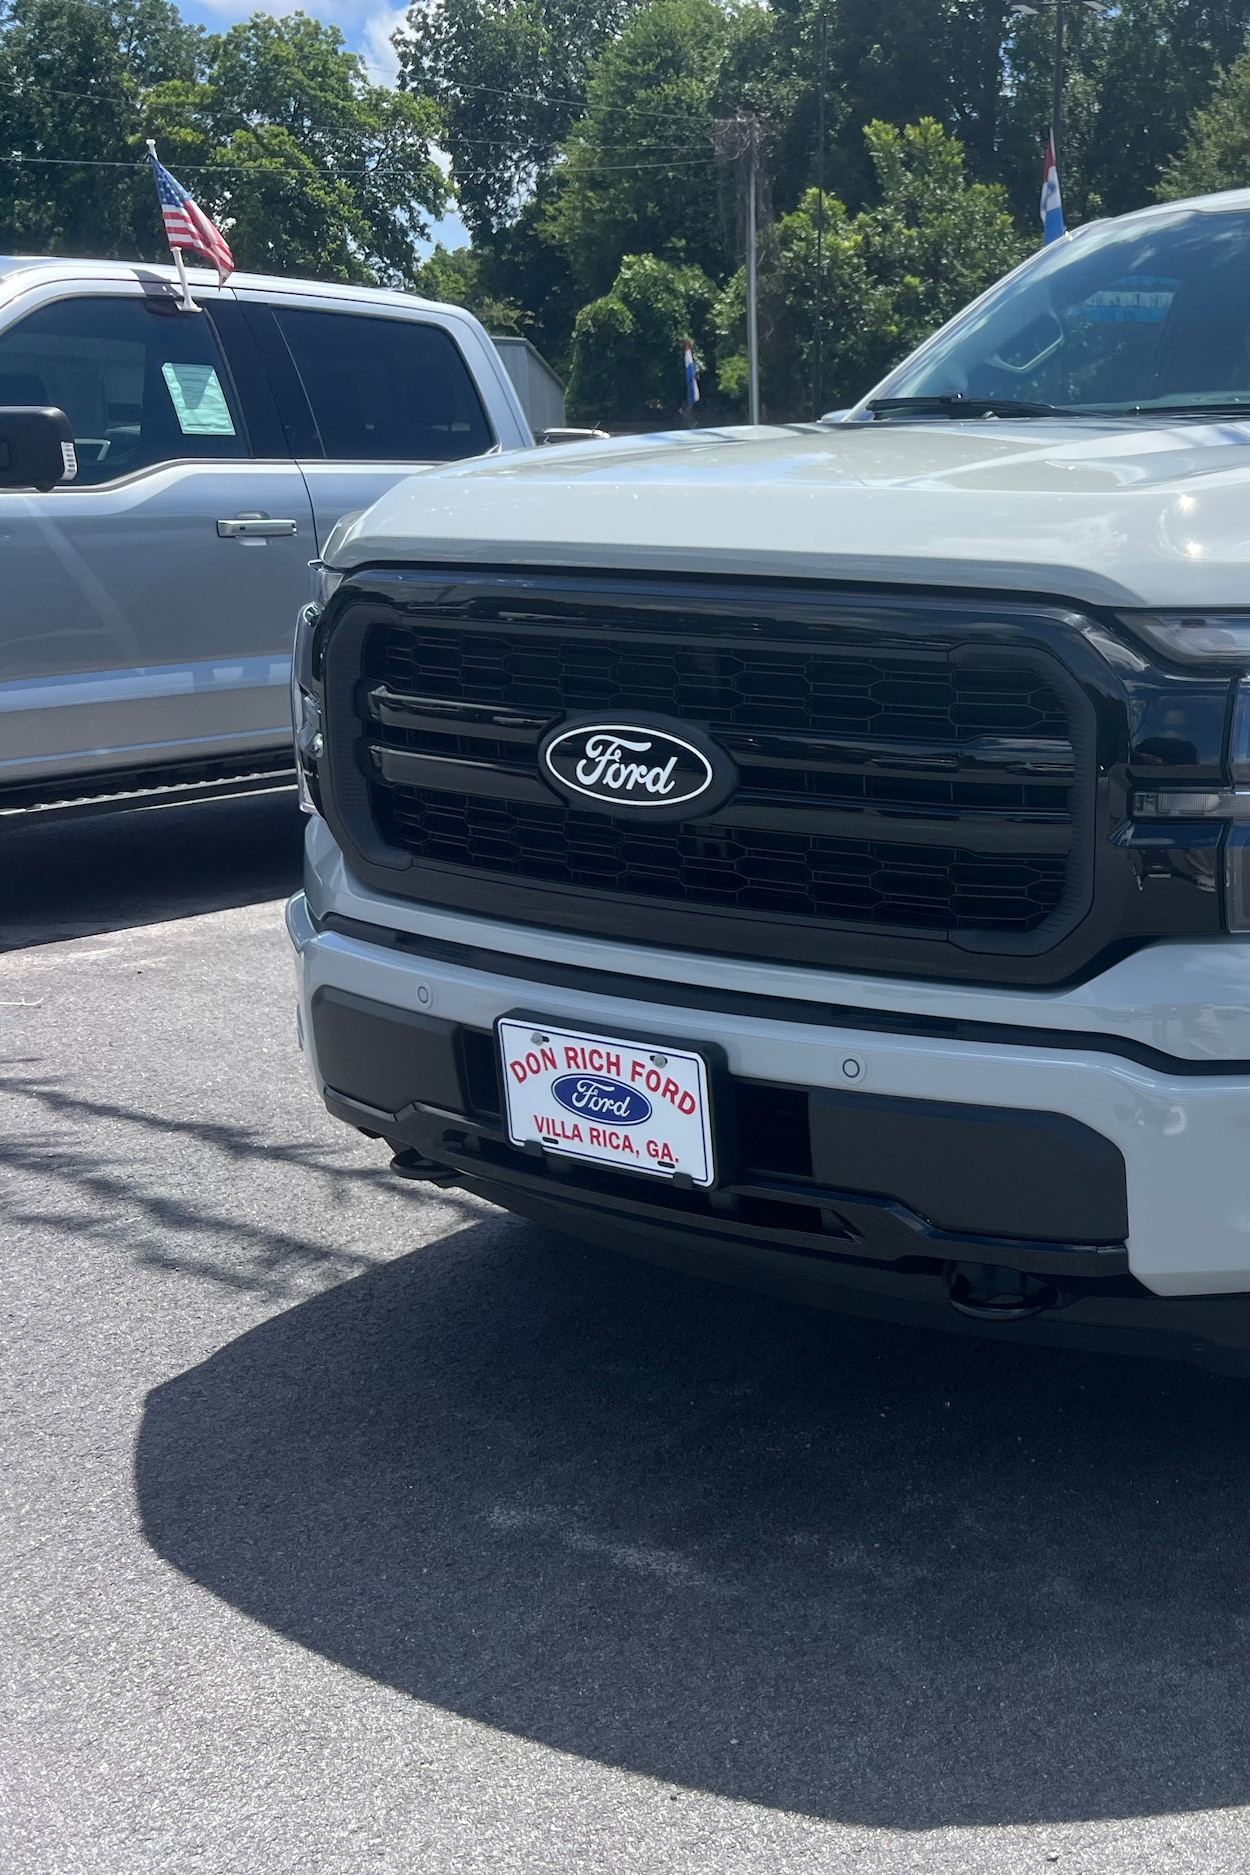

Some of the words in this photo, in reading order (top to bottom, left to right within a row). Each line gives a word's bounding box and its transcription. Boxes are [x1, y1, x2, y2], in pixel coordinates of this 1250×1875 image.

[576, 734, 678, 794] Ford
[509, 1047, 557, 1084] DON
[564, 1046, 621, 1076] RICH
[630, 1060, 696, 1115] FORD
[571, 1079, 631, 1117] Ford
[533, 1114, 583, 1142] VILLA
[589, 1126, 639, 1158] RICA,
[646, 1139, 680, 1163] GA.
